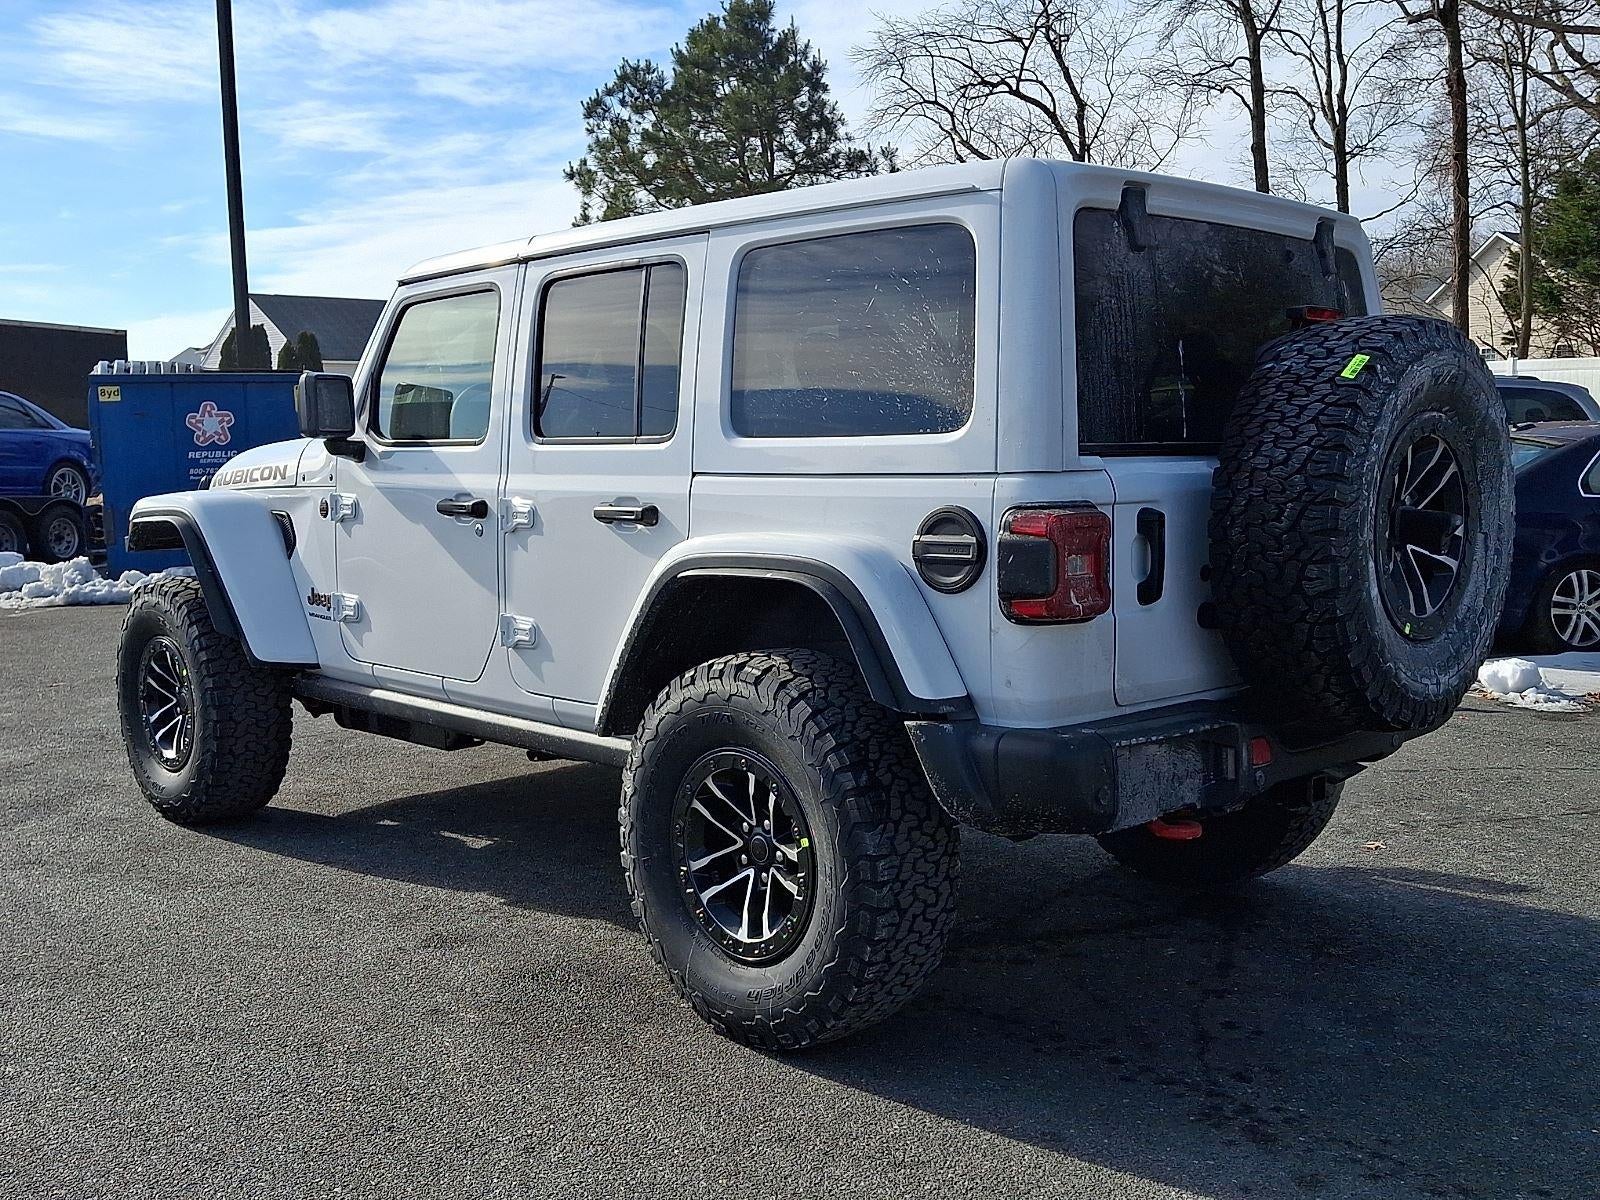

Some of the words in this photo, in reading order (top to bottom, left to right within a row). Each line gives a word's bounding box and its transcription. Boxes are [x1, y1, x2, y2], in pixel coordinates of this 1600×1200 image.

[100, 387, 120, 399] 8yd
[187, 450, 238, 459] REPUBLIC
[212, 464, 288, 488] RUBICON
[307, 586, 332, 611] Jeep
